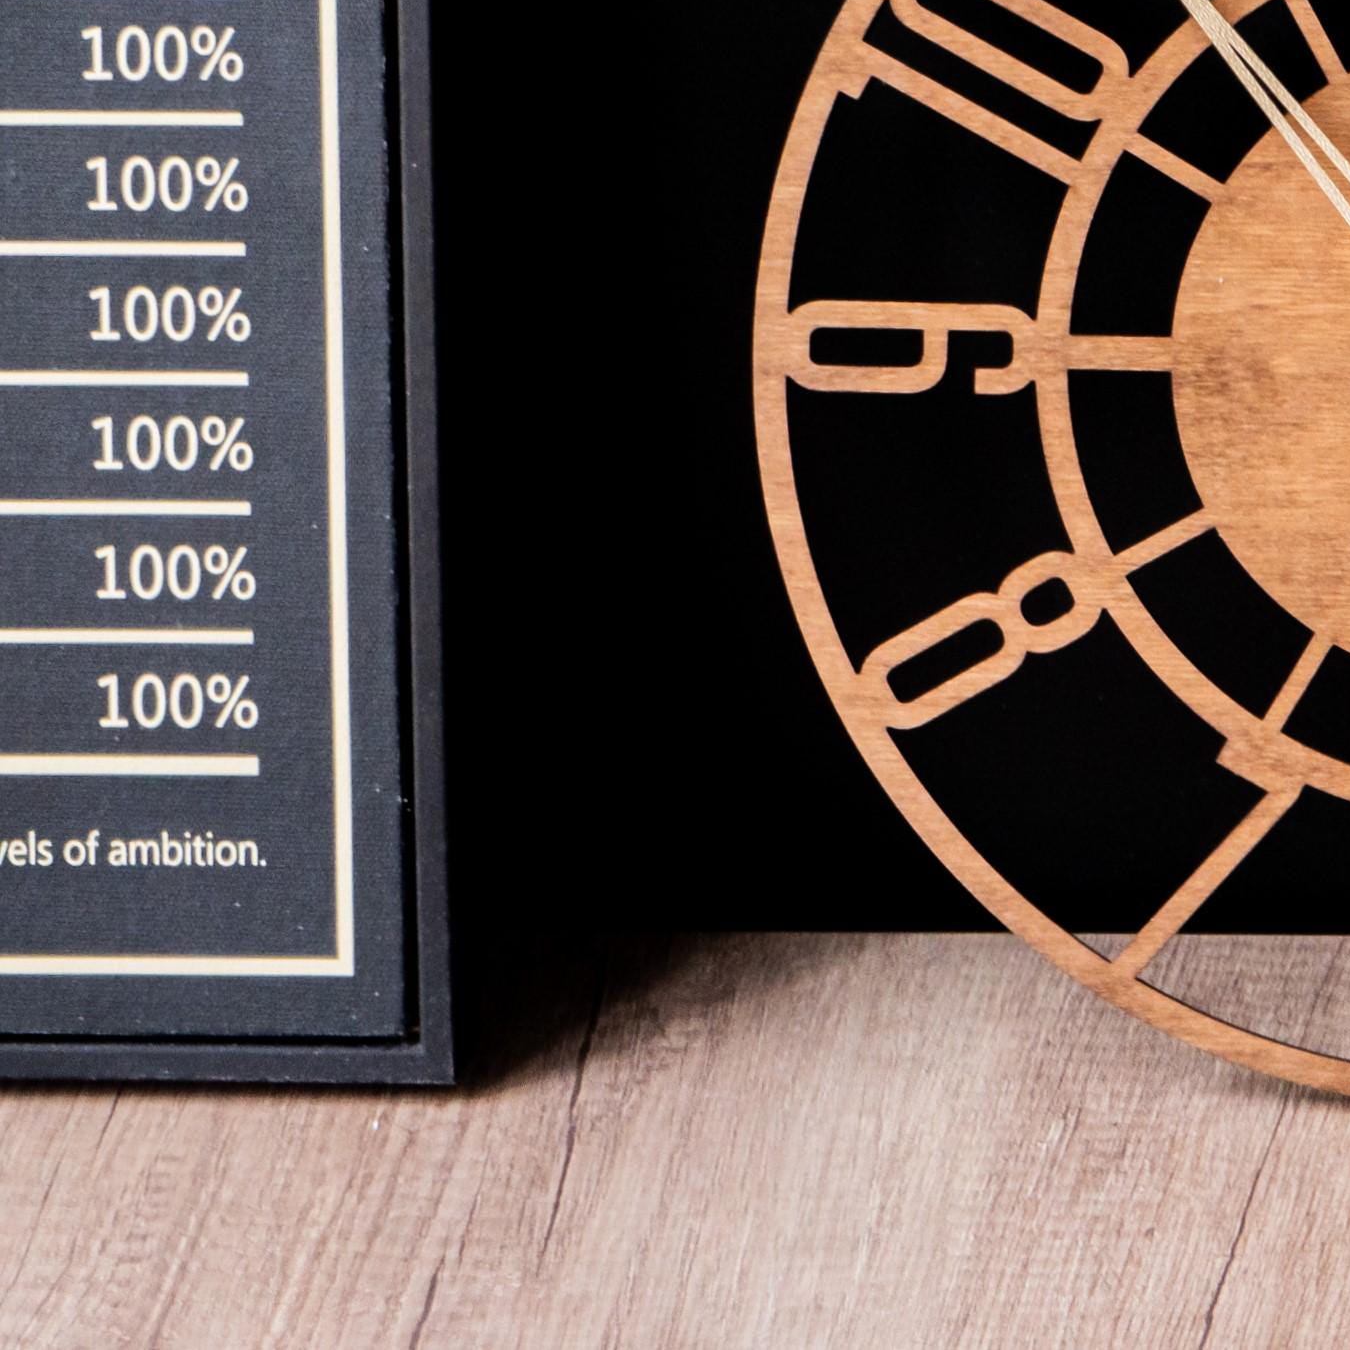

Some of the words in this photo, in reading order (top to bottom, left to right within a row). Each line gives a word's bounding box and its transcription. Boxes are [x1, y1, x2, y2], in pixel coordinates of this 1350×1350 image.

[81, 24, 245, 82] 100%
[85, 155, 249, 213] 100%
[88, 285, 252, 343] 100%
[782, 298, 1042, 396] 9
[91, 415, 254, 472] 100%
[94, 544, 257, 601] 100%
[848, 550, 1106, 731] 8
[97, 673, 259, 729] 100%
[62, 829, 101, 867] of
[107, 830, 267, 867] ambition.
[1110, 734, 1307, 981] 7
